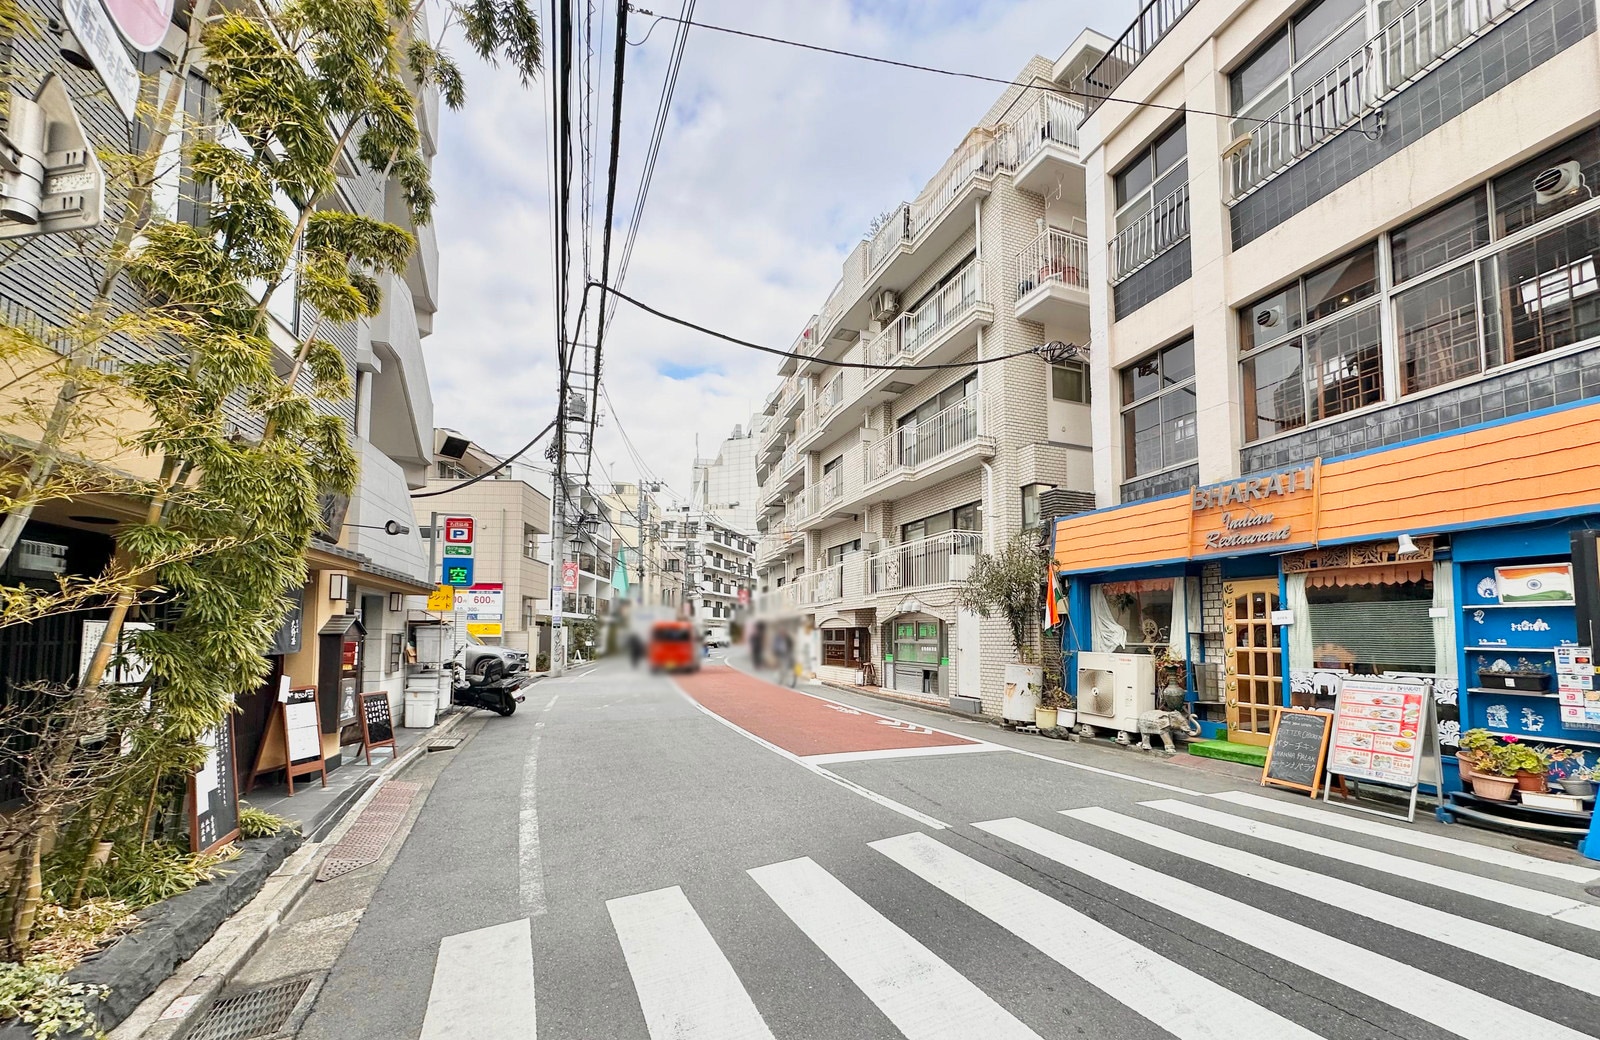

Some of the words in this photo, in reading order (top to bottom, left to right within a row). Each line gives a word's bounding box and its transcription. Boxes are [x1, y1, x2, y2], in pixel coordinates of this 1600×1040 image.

[1192, 465, 1314, 511] BHARATI
[1221, 511, 1275, 530] Indian
[453, 530, 465, 538] P
[1204, 525, 1292, 550] Restaurant
[449, 567, 468, 583] 空
